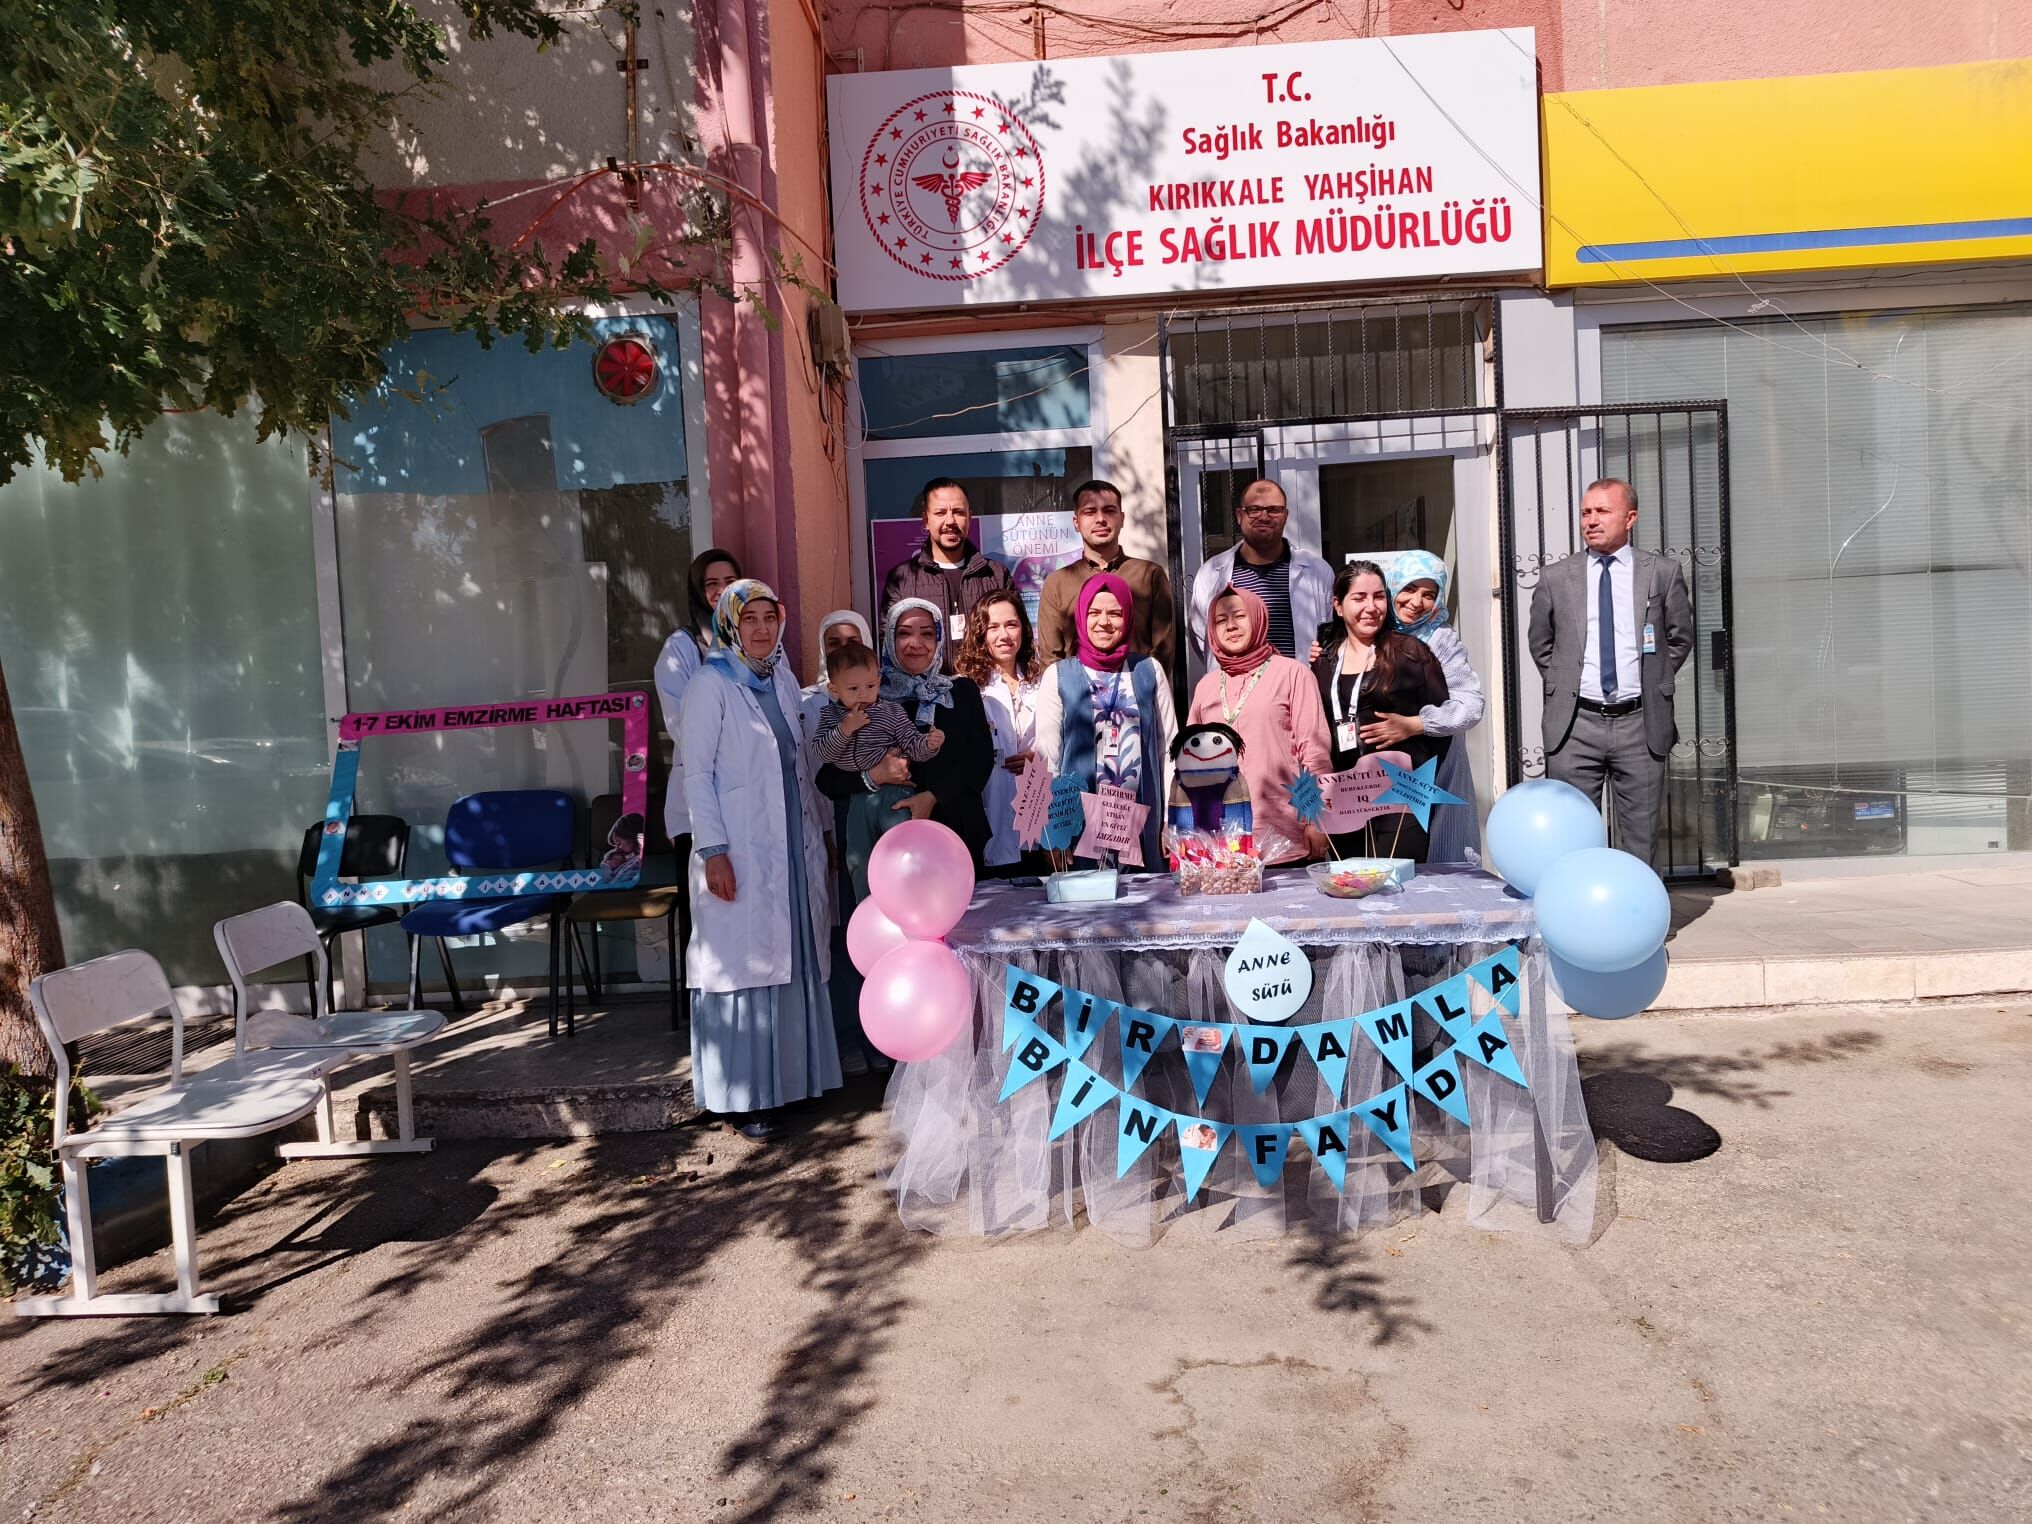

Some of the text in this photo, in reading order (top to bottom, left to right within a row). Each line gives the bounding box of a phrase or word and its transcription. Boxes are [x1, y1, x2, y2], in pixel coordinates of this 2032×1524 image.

[1262, 72, 1312, 104] T.C.
[1182, 113, 1396, 162] Sağlık Bakanlığı
[893, 123, 1012, 240] TÜRKİYE CUMHURİYETİ SAĞLIK BAKANLIĞI
[1149, 161, 1434, 213] KIRIKKALE YAHŞİHAN
[1076, 197, 1513, 278] İLÇE SAĞLIK MÜDÜRLÜĞÜ
[1002, 527, 1070, 542] SÜTÜNÜN
[1015, 514, 1054, 527] ANNE
[1012, 541, 1059, 555] ÖNEMİ
[352, 696, 631, 732] 1-7 EKİM EMZİRME HAFTASI
[1356, 794, 1370, 803] IQ
[1237, 952, 1292, 975] ANNE
[1251, 978, 1293, 1002] SÜTÜ
[1010, 963, 1517, 1065] BİR DAMLA
[1017, 1030, 1508, 1166] BİN FAYDA
